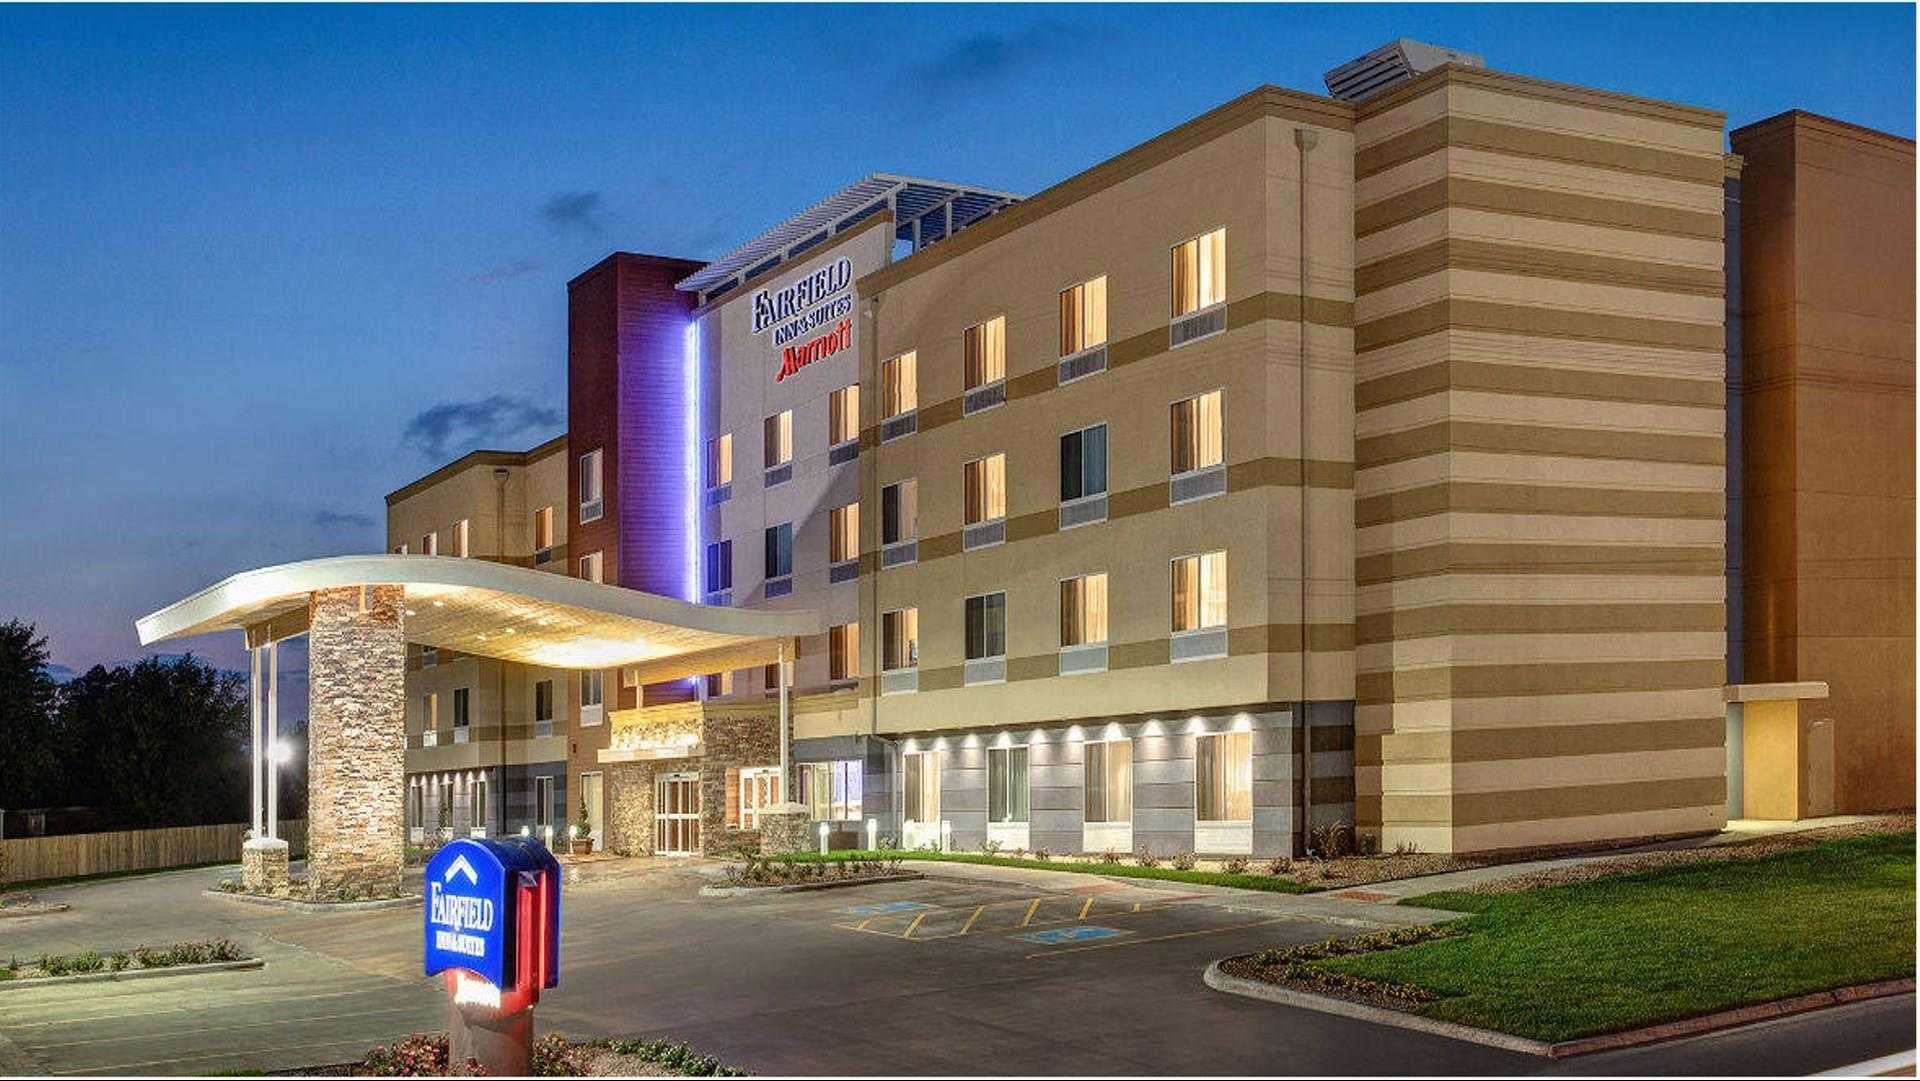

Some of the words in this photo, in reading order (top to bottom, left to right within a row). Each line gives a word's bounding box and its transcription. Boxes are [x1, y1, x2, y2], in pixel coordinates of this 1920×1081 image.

[752, 257, 852, 333] FAIRFIELD
[776, 318, 852, 383] Marriott
[431, 881, 493, 931] FAIRFIELD
